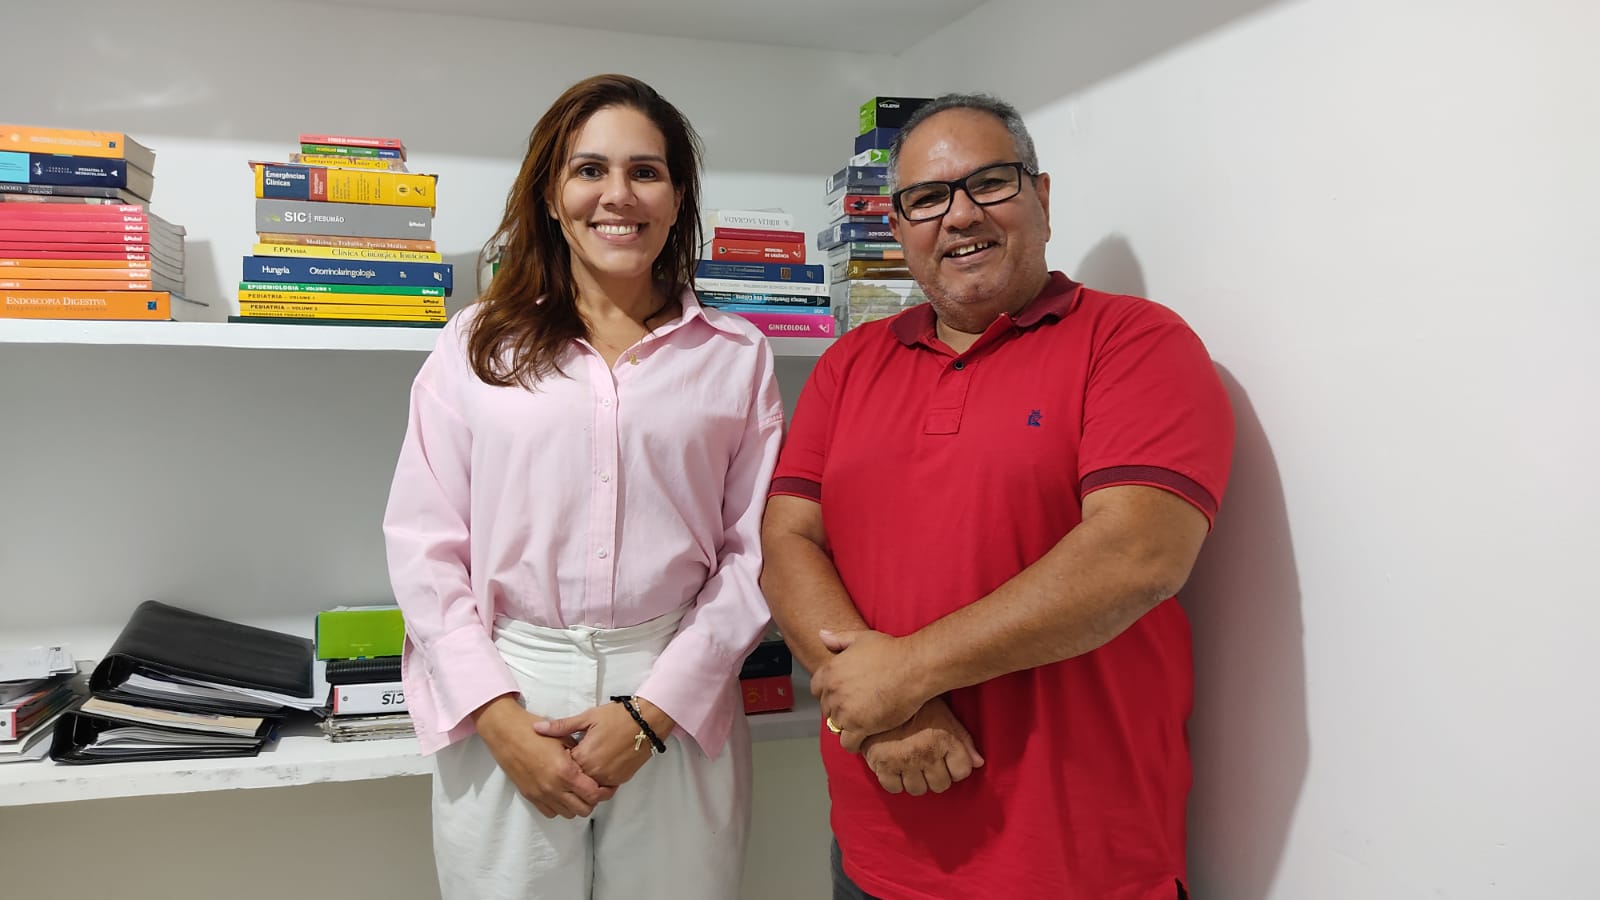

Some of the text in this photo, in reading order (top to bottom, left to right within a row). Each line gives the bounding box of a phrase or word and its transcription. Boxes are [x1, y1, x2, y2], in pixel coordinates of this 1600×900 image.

[265, 170, 306, 180] Emergências
[265, 178, 291, 187] Clínicas
[284, 211, 306, 223] SIC
[314, 215, 345, 224] RESUMÃO
[261, 265, 290, 276] Hungria
[309, 266, 377, 279] Otorrinolaringologia
[6, 296, 107, 306] ENDOSCOPIA DIGESTIVA
[768, 323, 810, 331] GINECOLOGIA
